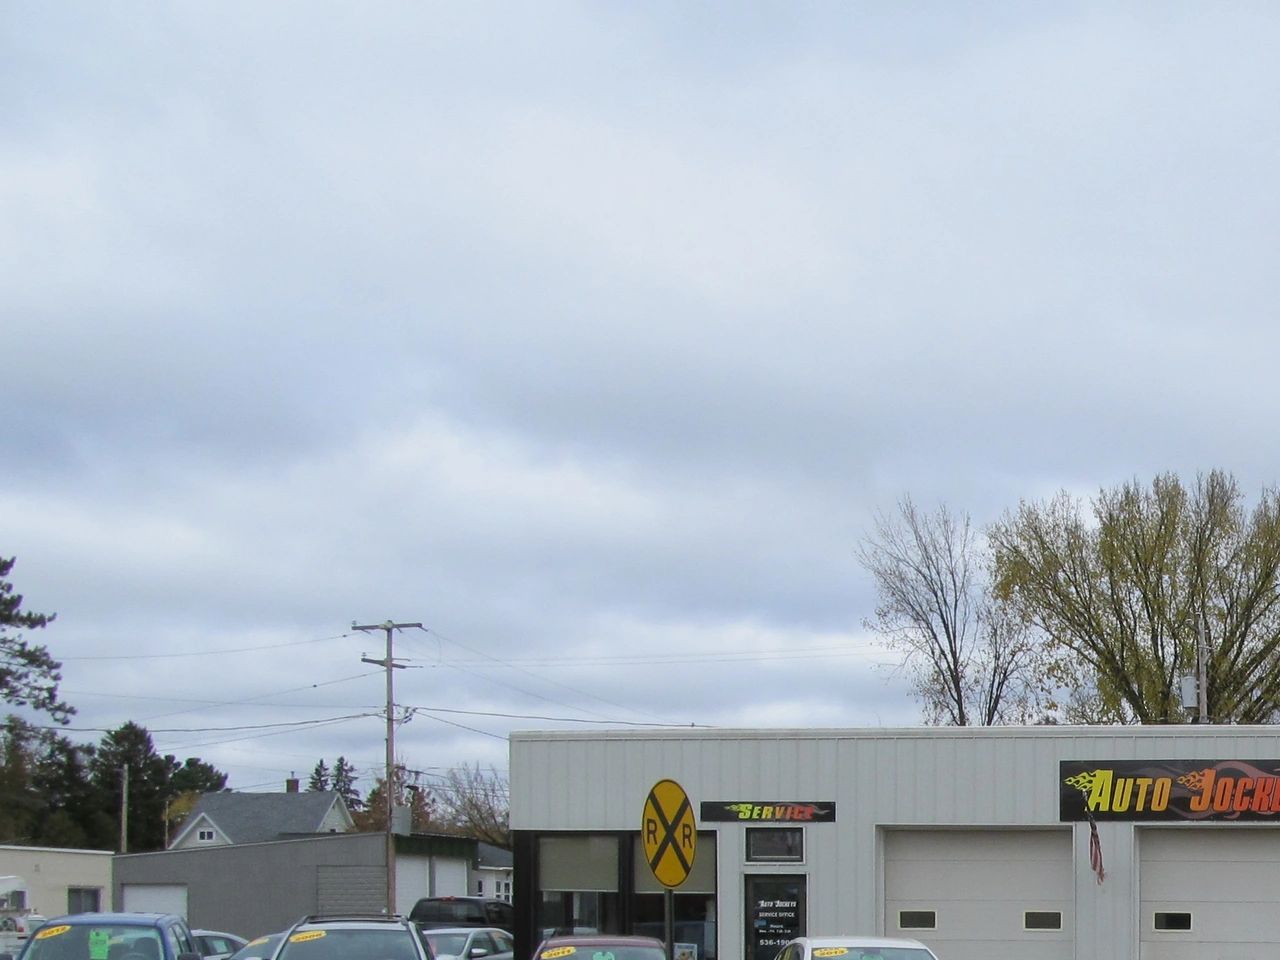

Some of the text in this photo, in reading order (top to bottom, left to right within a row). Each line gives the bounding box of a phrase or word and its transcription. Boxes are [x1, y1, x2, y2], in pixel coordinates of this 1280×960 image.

[1085, 769, 1173, 813] AUTO
[736, 803, 815, 820] SERVICE
[646, 818, 693, 849] R R
